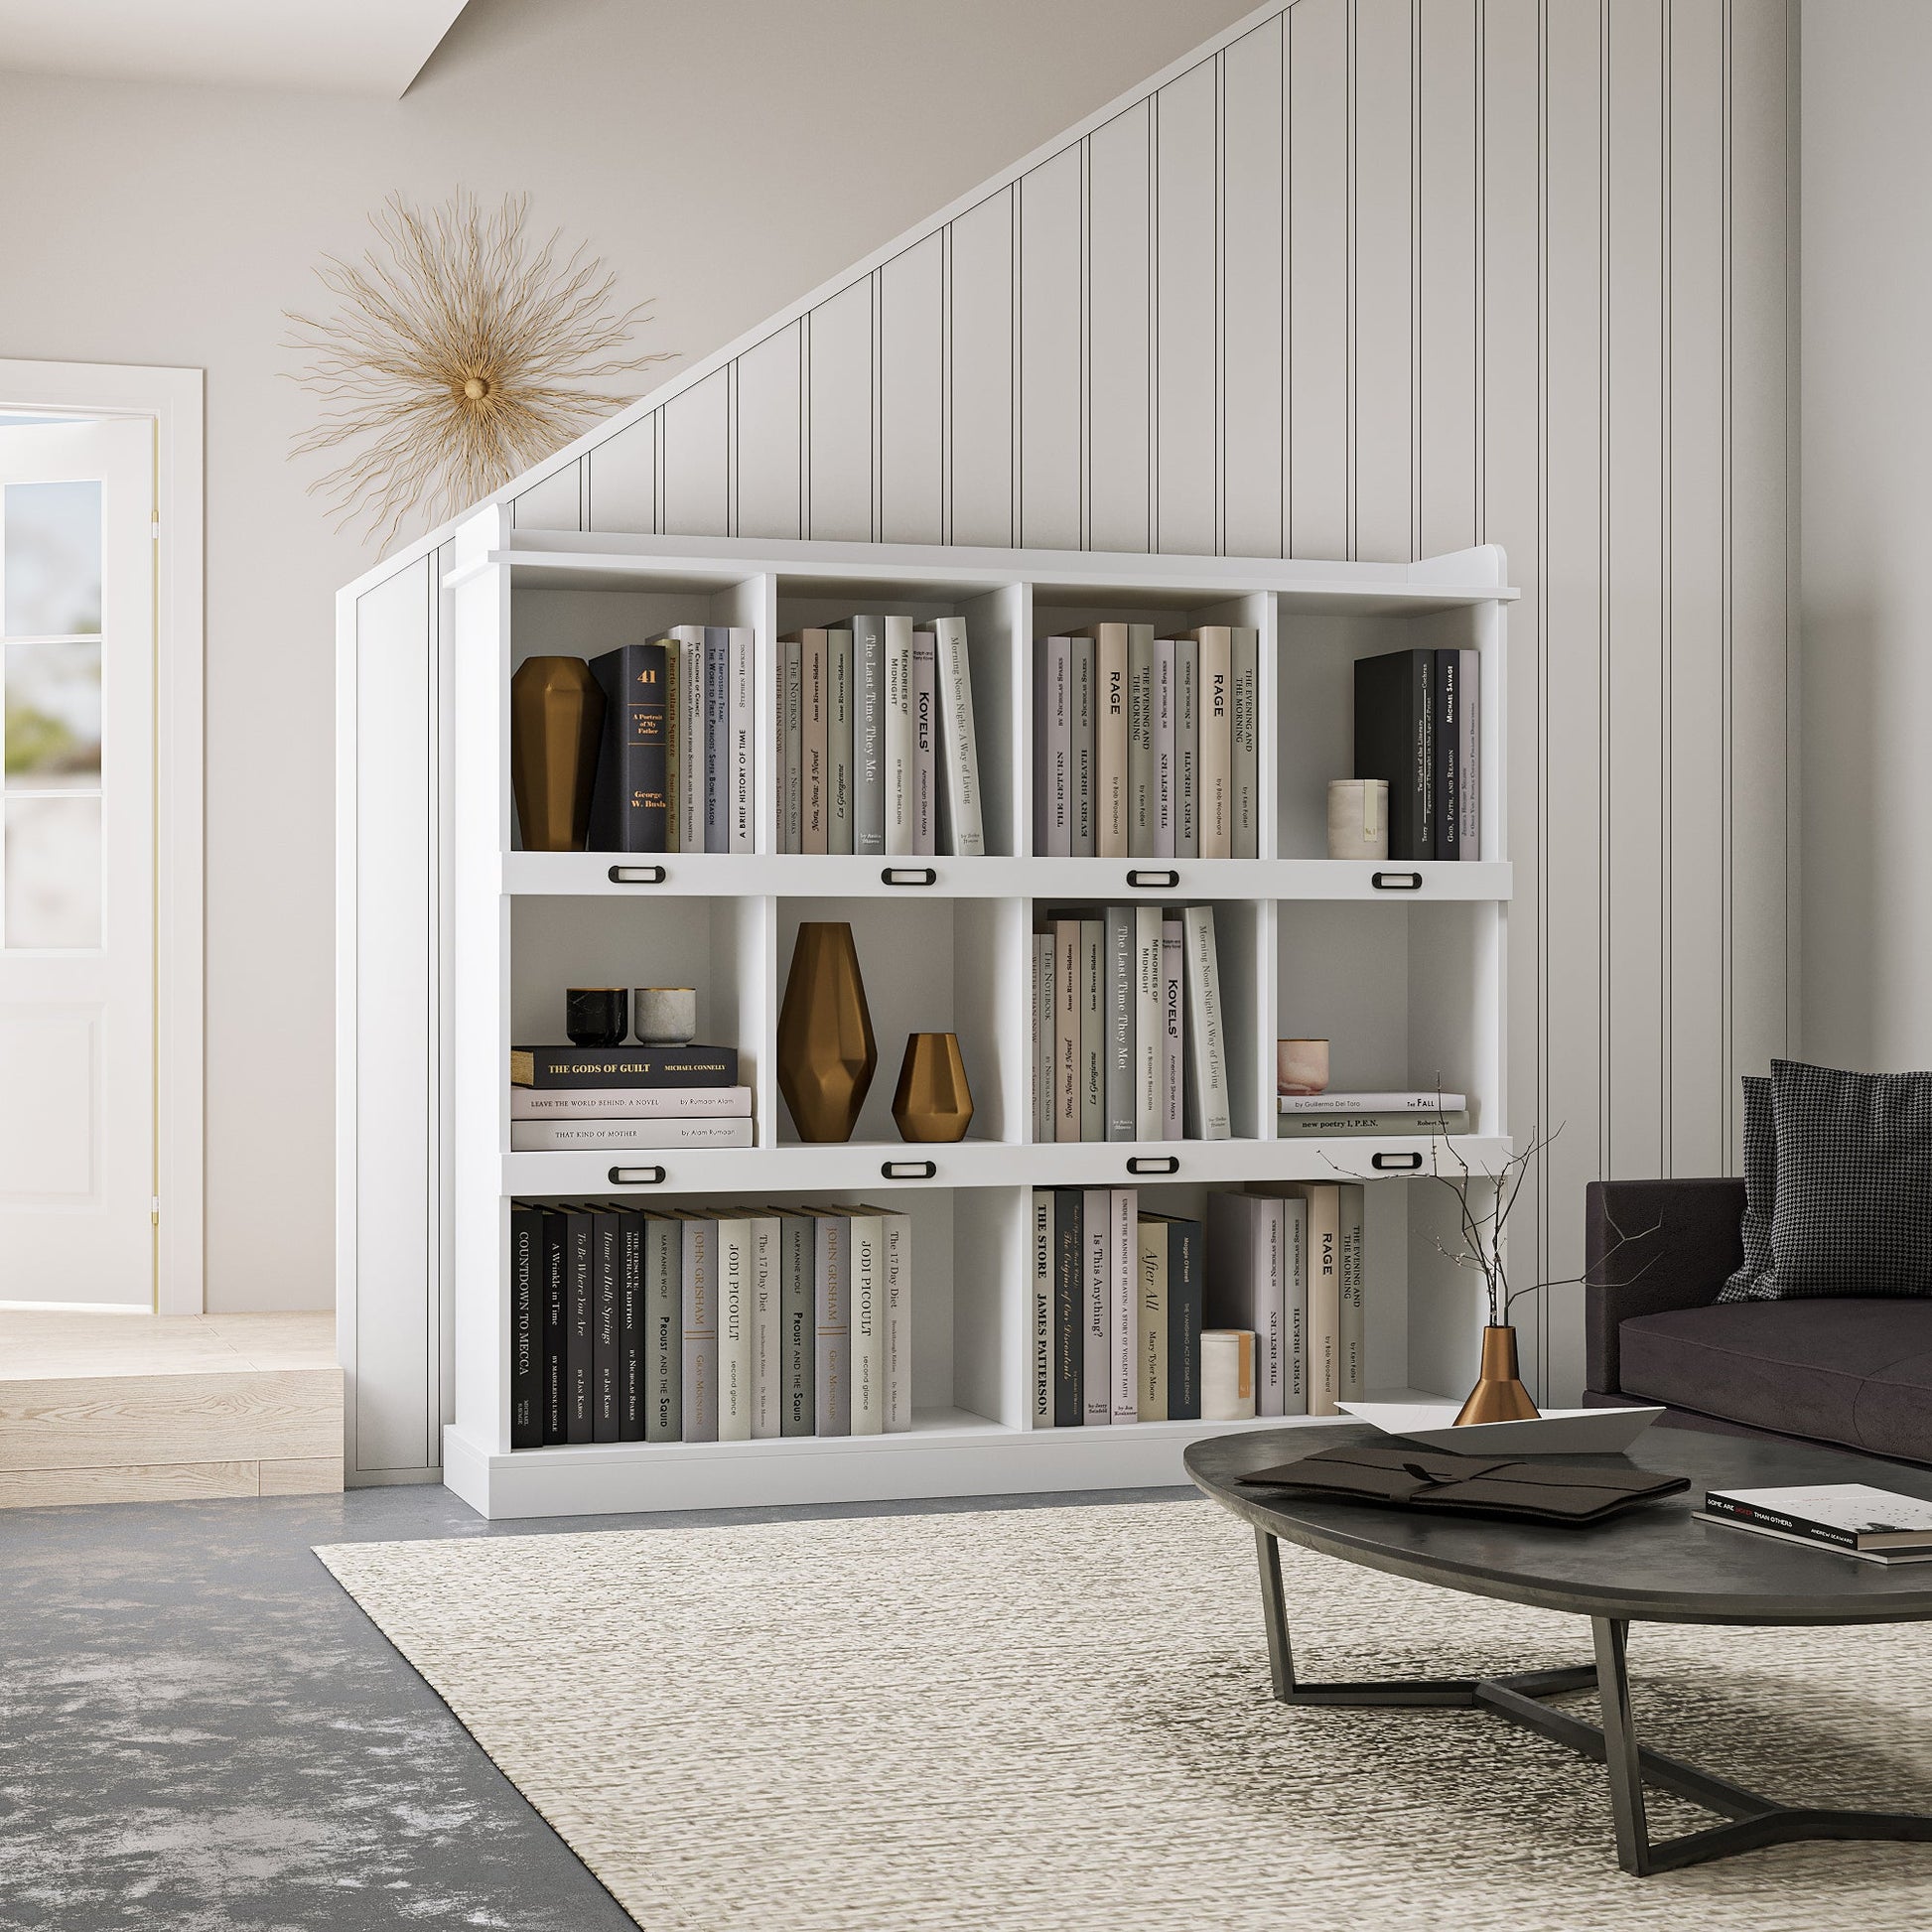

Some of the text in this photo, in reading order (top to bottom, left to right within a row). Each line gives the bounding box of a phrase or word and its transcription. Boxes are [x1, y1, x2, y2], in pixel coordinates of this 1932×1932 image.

[637, 670, 656, 683] 41
[1111, 672, 1120, 715] RAGE
[1214, 674, 1223, 717] RAGE
[866, 635, 876, 782] The Last Time They Met
[919, 692, 929, 753] KOVELS'
[634, 790, 662, 800] George
[962, 776, 971, 805] Living
[1169, 980, 1177, 1038] KOVELS'
[548, 1064, 650, 1074] THE GODS OF GUILT
[891, 1253, 898, 1264] 17
[1037, 1204, 1046, 1279] THE STORE
[1322, 1233, 1332, 1275] RAGE
[601, 1231, 614, 1345] Home to Holly Springs
[729, 1244, 739, 1340] JODI PICOULT
[827, 1228, 838, 1320] JOHN GRISHAM
[862, 1241, 872, 1336] JODI PICOULT
[1092, 1234, 1103, 1338] Is This Anything?
[1142, 1247, 1160, 1311] After All
[518, 1232, 529, 1376] COUNTDOWN TO MECCA
[794, 1312, 803, 1346] PROUST
[660, 1316, 670, 1351] PROUST
[1037, 1294, 1046, 1416] JAMES PATTERSON
[1148, 1331, 1157, 1401] Mary Tyler Moore
[660, 1398, 670, 1427] SQUID
[794, 1393, 803, 1422] SQUID
[1754, 1511, 1770, 1521] THAN
[1770, 1516, 1793, 1528] OTHERS
